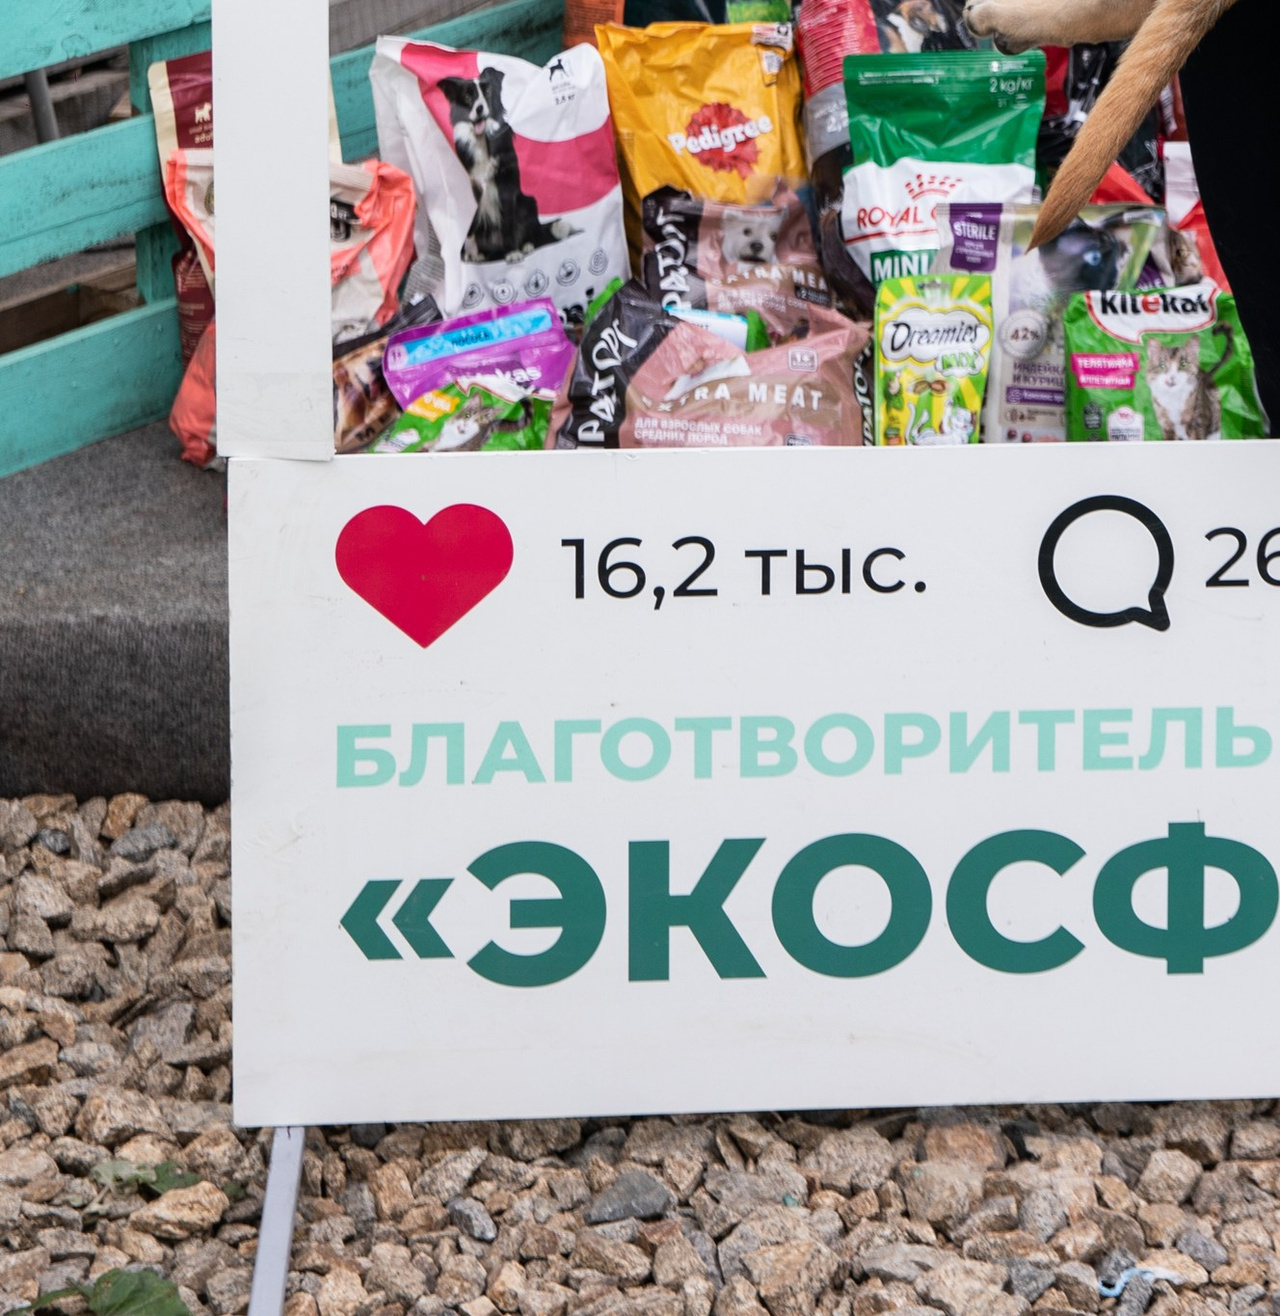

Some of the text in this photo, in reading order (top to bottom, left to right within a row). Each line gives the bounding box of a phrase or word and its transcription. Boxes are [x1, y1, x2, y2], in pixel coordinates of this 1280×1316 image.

[667, 112, 774, 159] Pedigree
[857, 206, 924, 230] ROYAL
[953, 220, 997, 241] STERILE
[872, 254, 929, 282] MINI
[890, 320, 979, 352] Dreamies
[1010, 327, 1041, 341] 42%
[941, 351, 979, 370] MIX
[748, 382, 823, 412] MEAT
[560, 536, 927, 610] 16,2 тыс.
